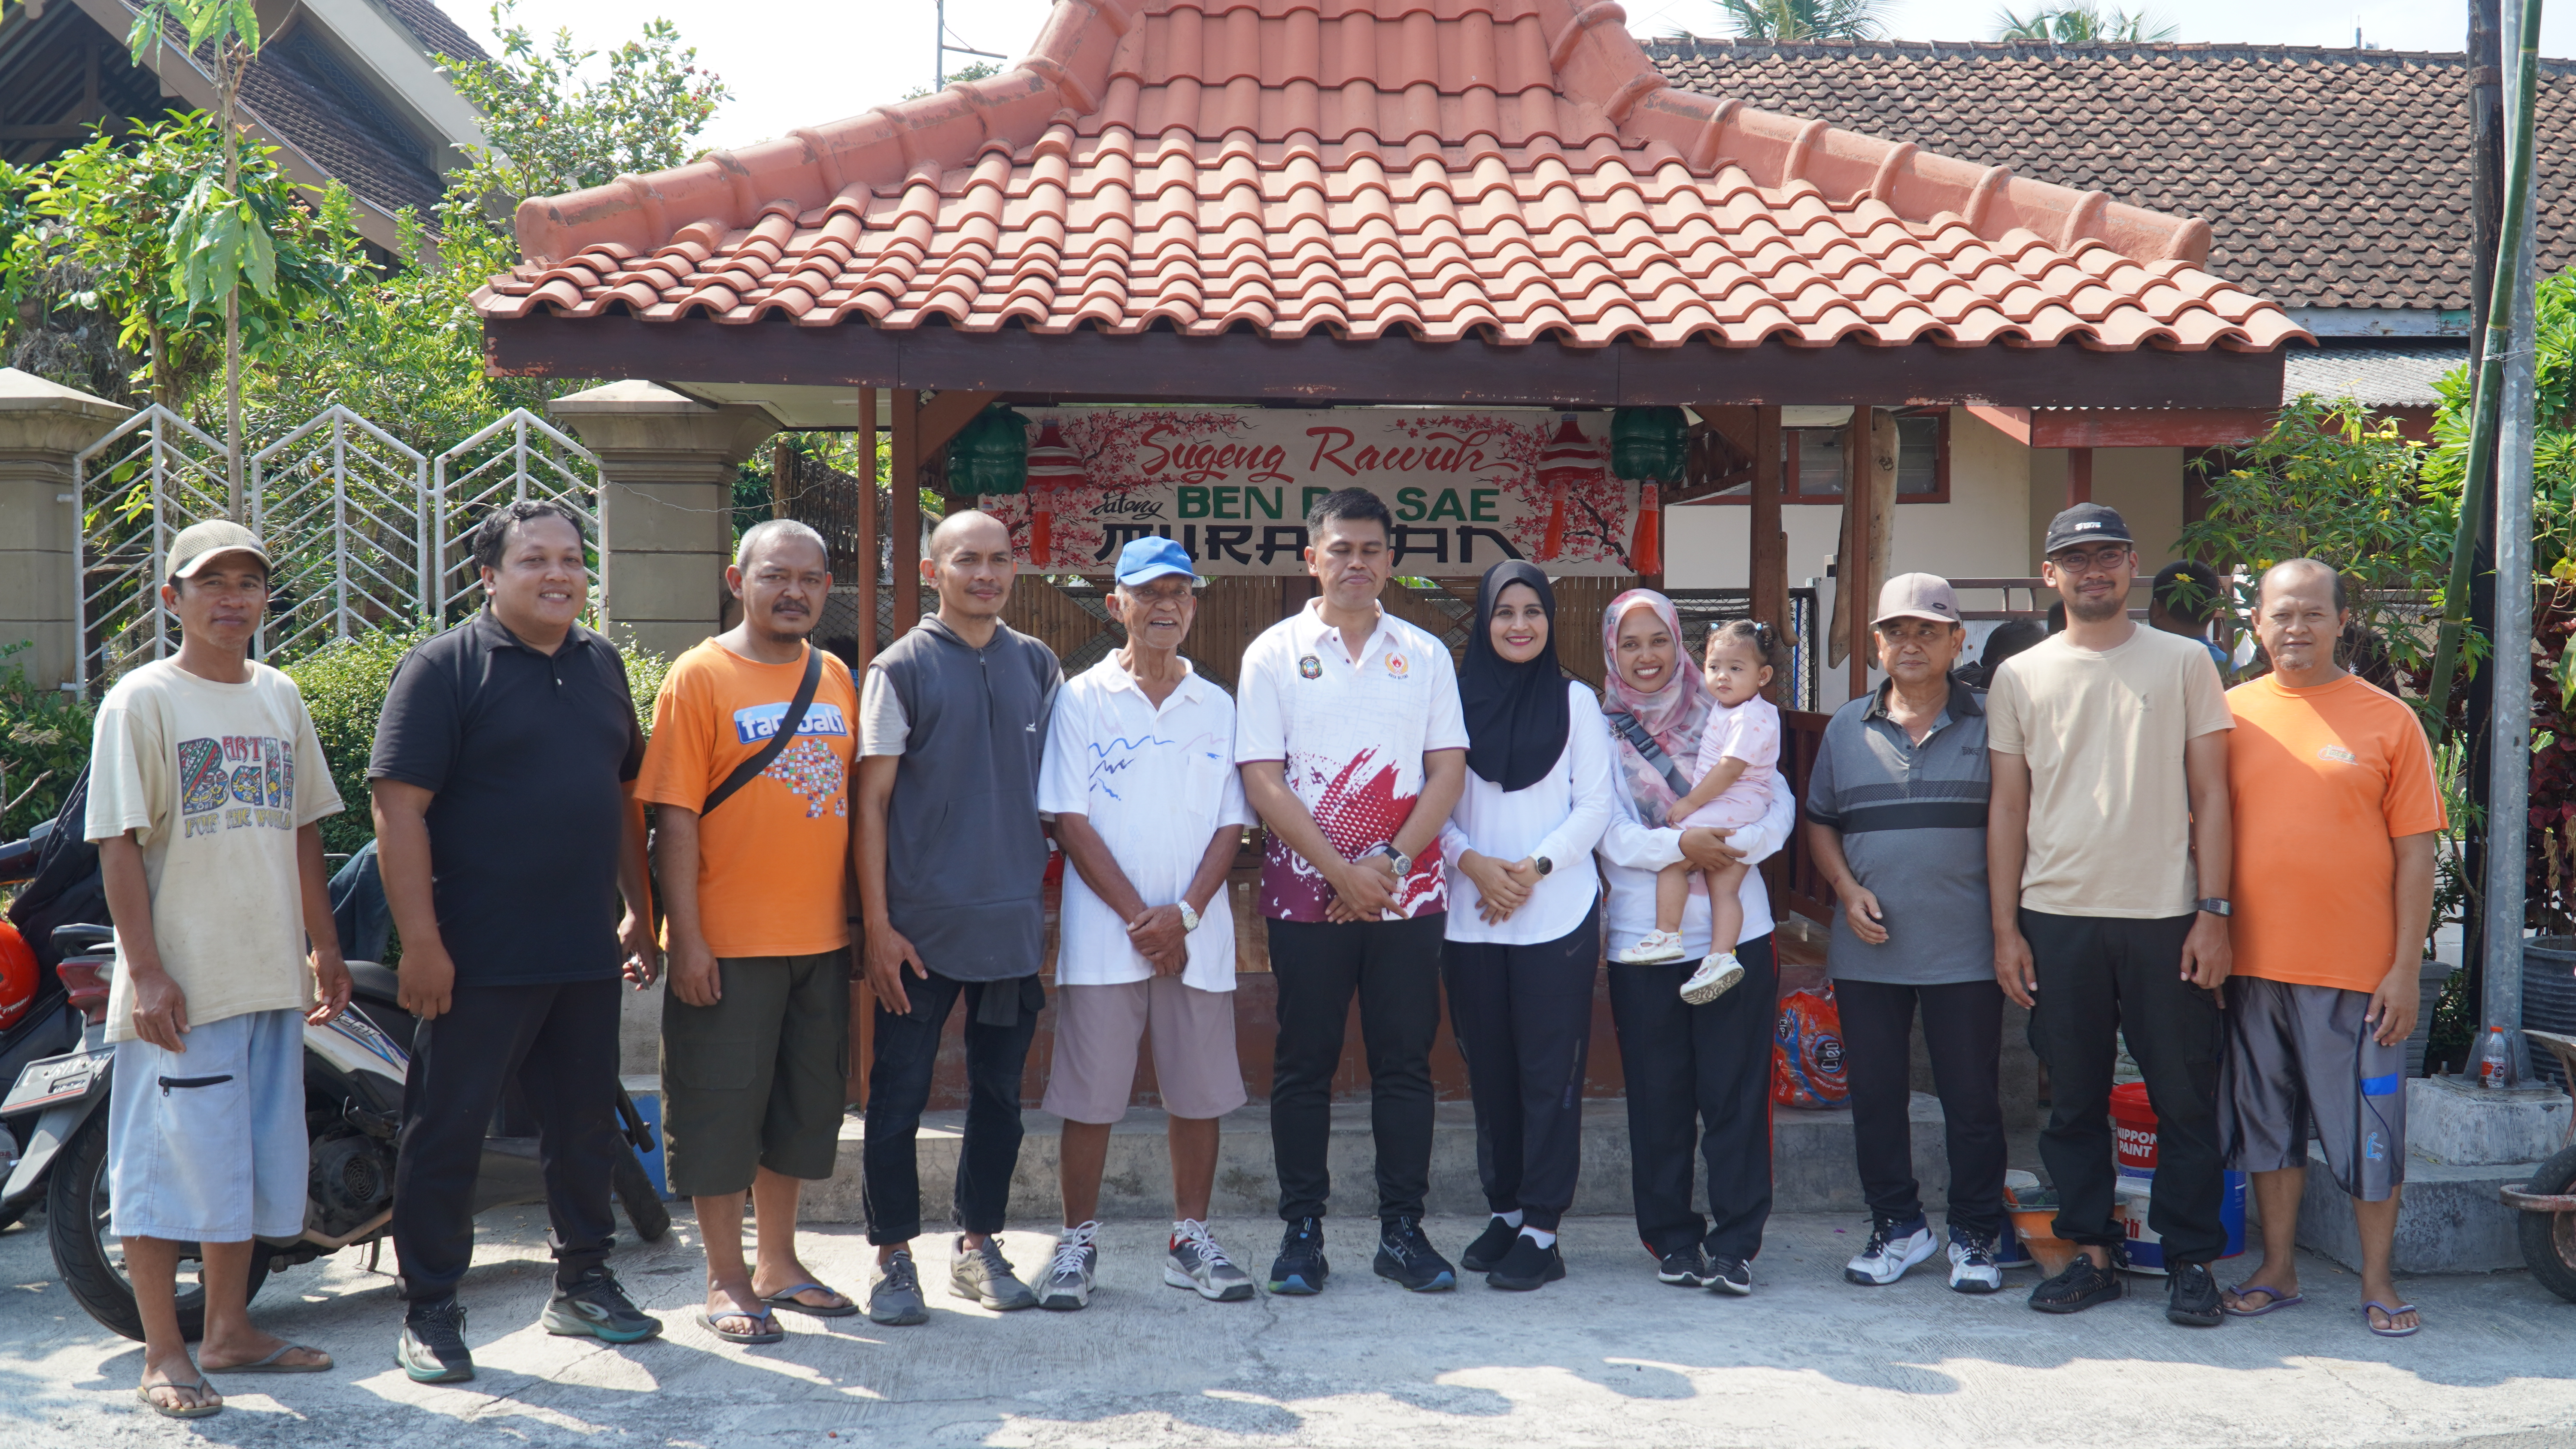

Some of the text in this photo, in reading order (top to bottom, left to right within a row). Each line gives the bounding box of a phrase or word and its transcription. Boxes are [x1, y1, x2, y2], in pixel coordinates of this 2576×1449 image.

[1141, 423, 1520, 484] Sugeng Rawuh
[1178, 485, 1283, 519] BEN
[1395, 487, 1500, 521] SAE
[1094, 523, 1526, 567] MURAAN
[222, 736, 264, 763] ART
[177, 737, 295, 815] Bali
[185, 812, 220, 838] FOR
[226, 807, 252, 829] THE
[333, 1013, 381, 1037] eAT
[2117, 1125, 2157, 1145] NIPPON
[2119, 1140, 2153, 1158] PAINT
